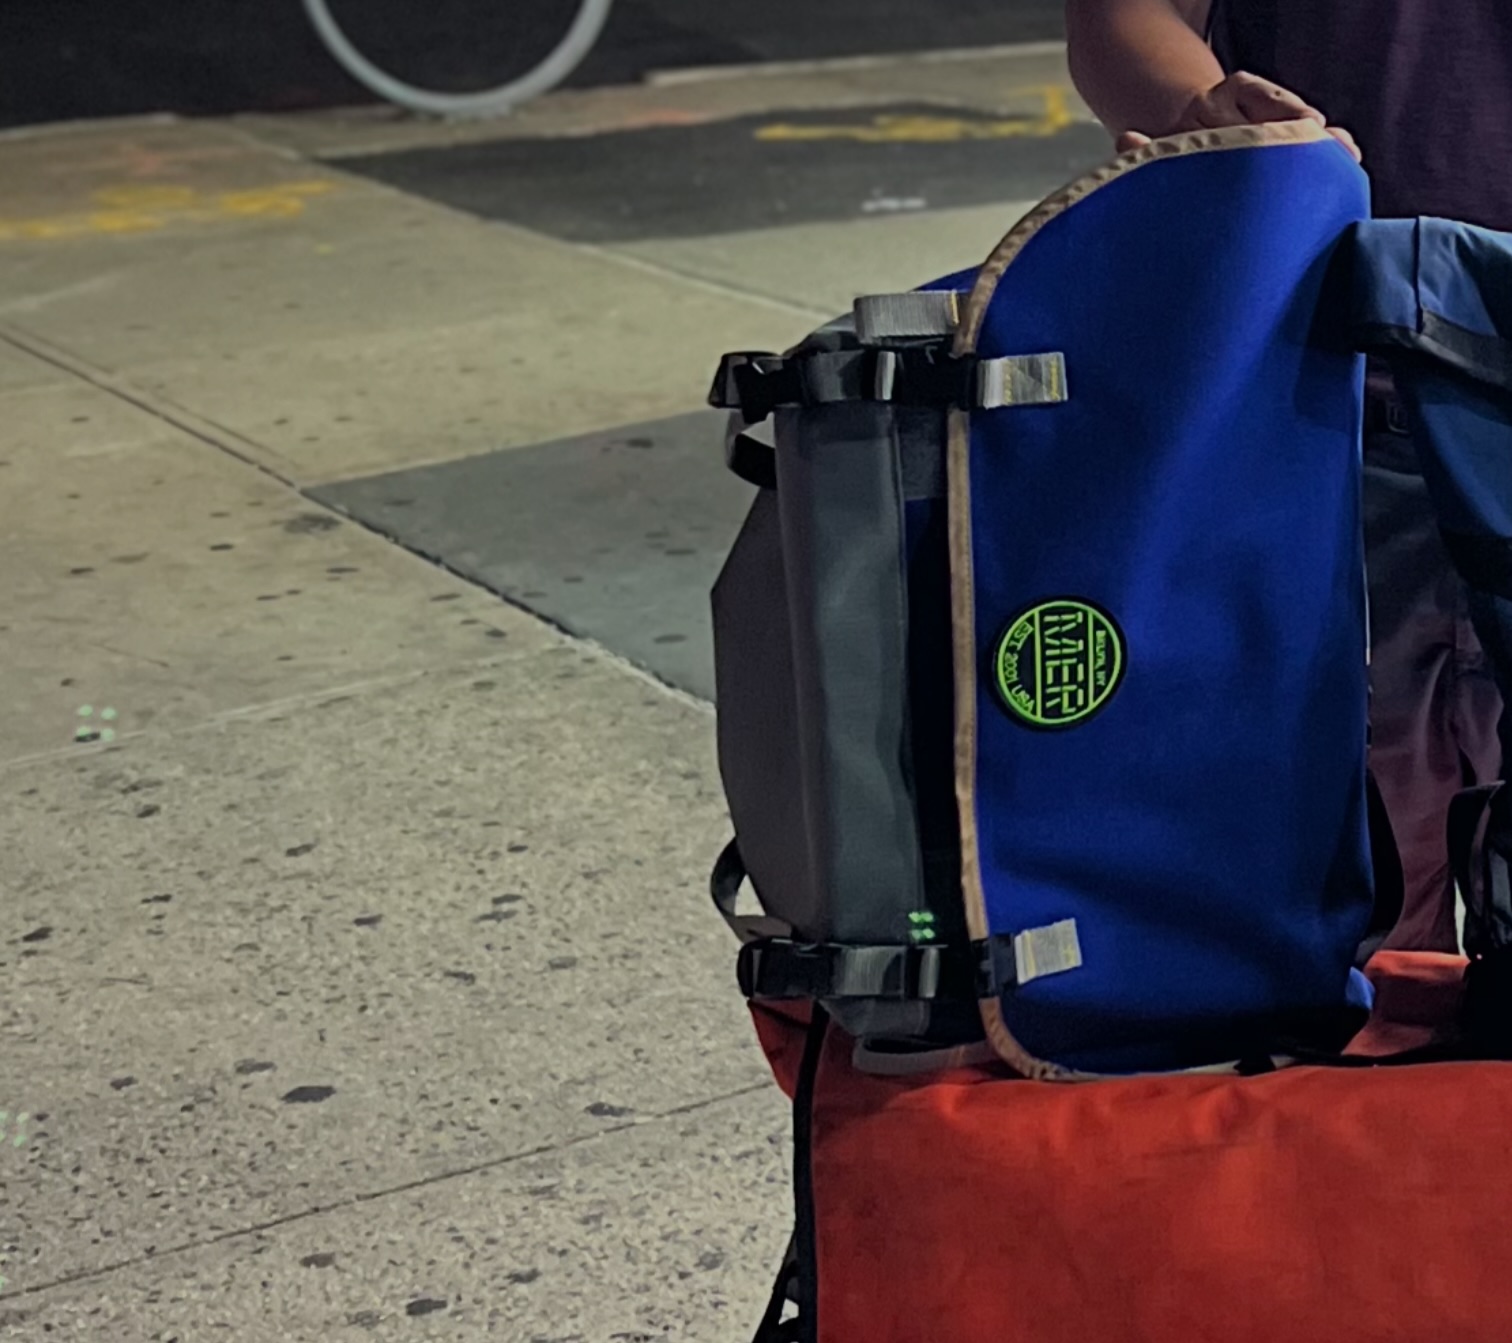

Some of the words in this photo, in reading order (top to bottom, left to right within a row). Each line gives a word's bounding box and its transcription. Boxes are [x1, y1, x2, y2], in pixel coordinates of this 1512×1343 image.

[1004, 652, 1019, 684] 2001
[1043, 611, 1085, 714] MER
[1011, 684, 1035, 714] USA
